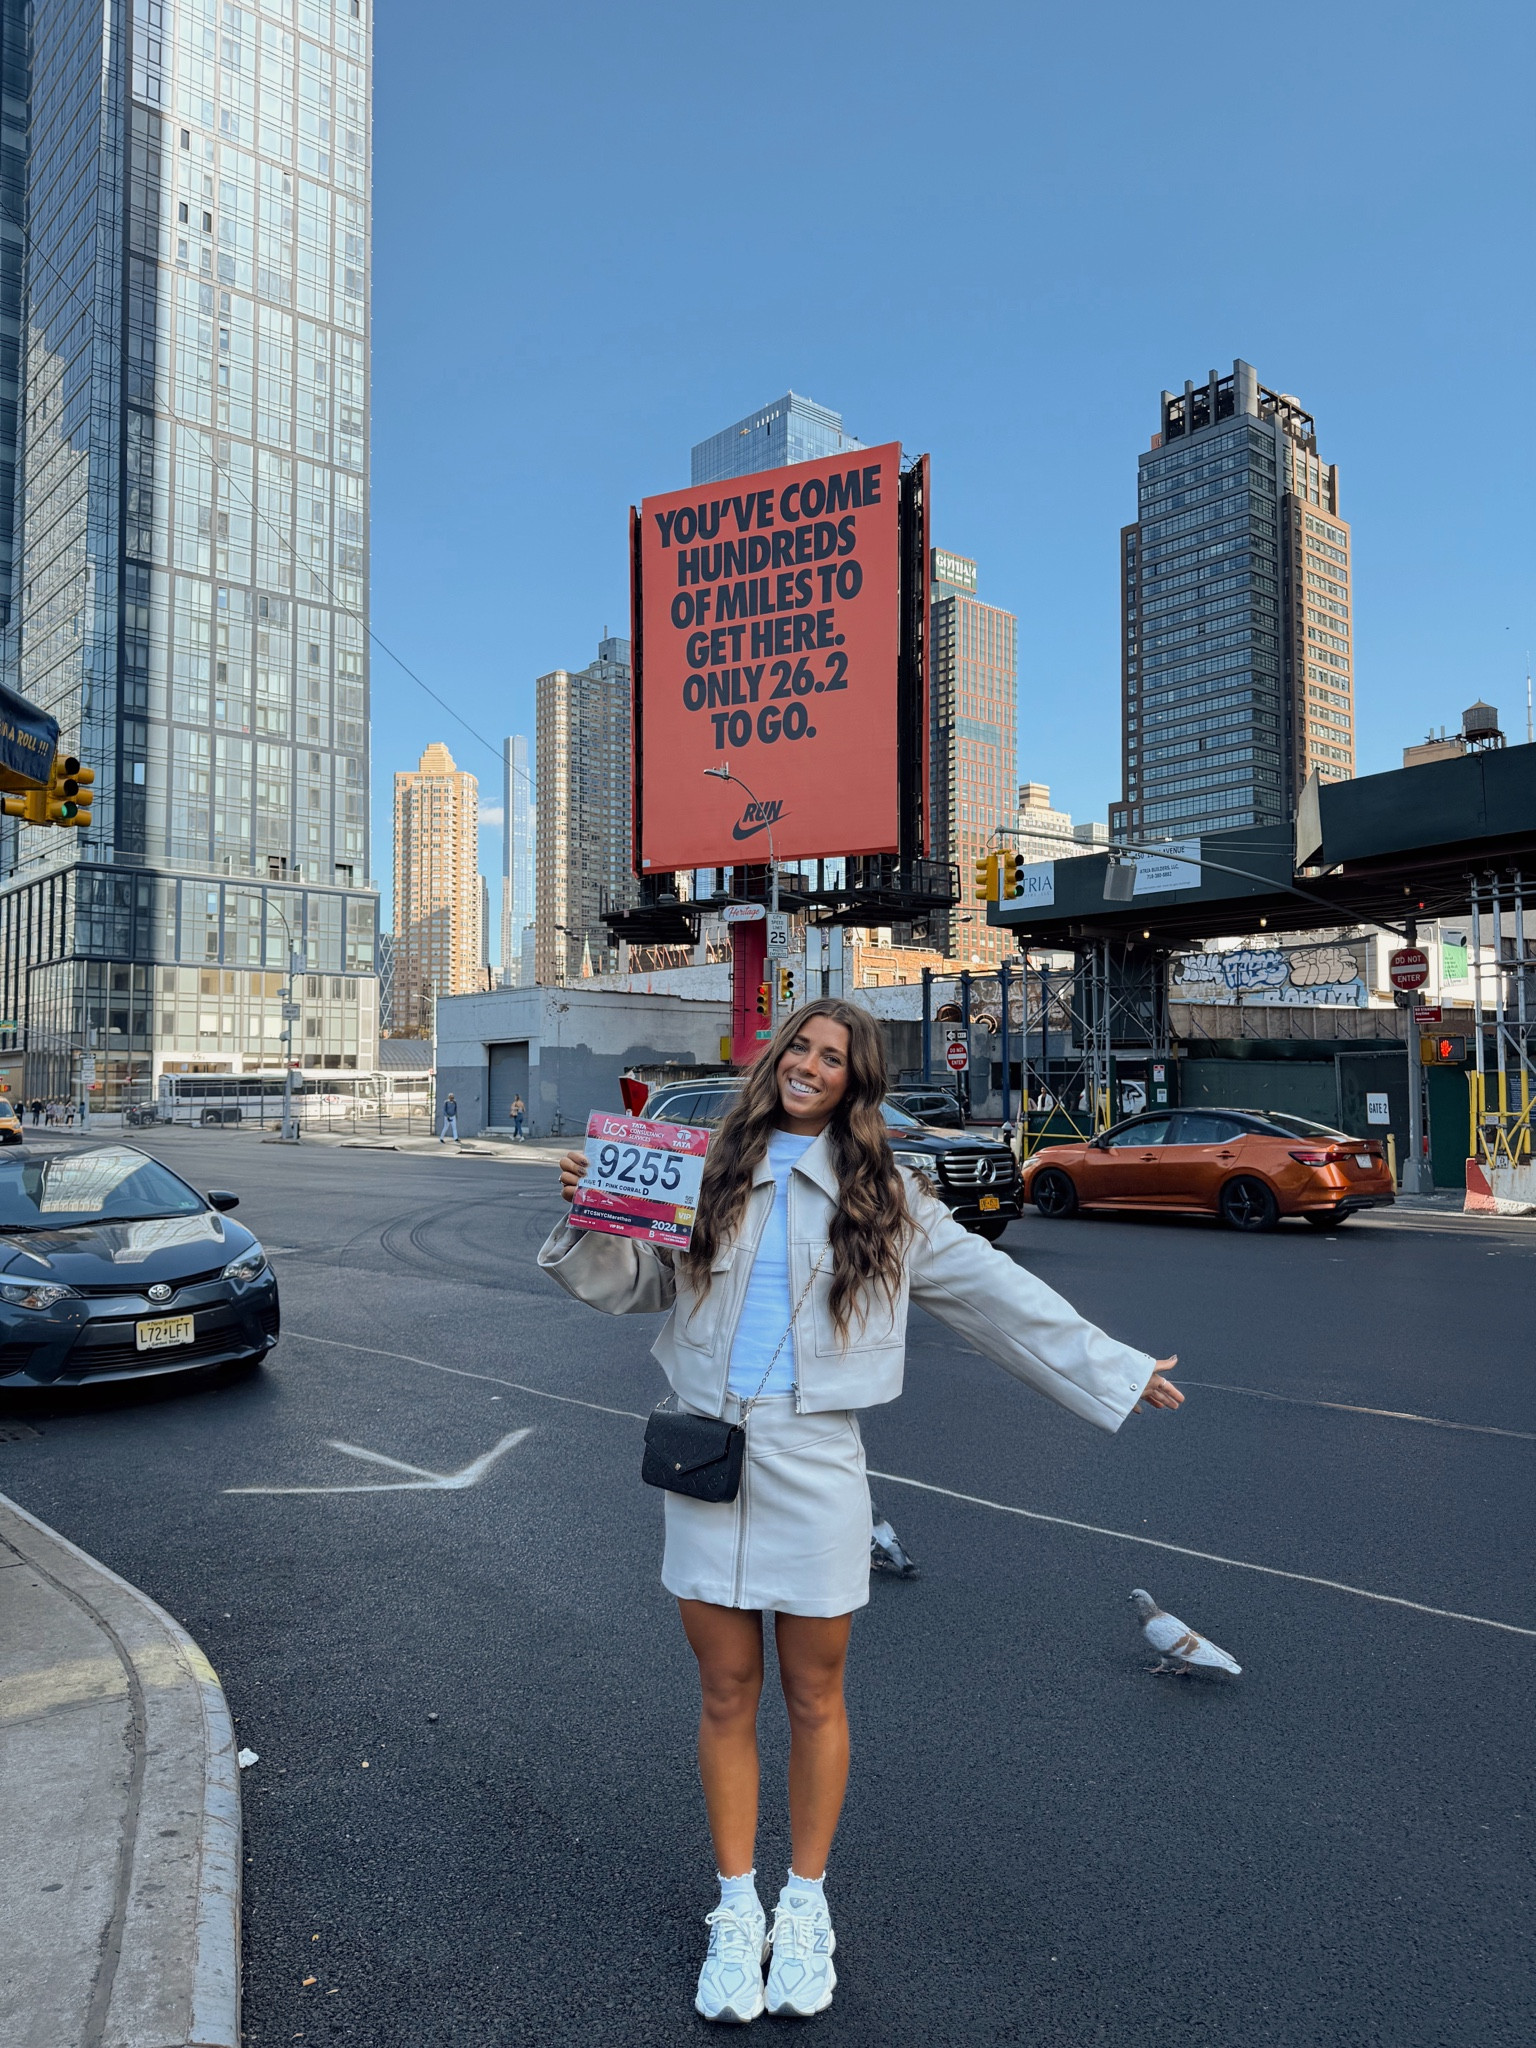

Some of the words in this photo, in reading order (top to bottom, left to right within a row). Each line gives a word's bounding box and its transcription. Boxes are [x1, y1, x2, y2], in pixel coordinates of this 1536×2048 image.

[655, 489, 775, 548] YOU'VE
[779, 464, 882, 523] COME
[677, 515, 857, 587] HUNDREDS
[671, 587, 712, 630] OF
[716, 568, 813, 621] MILES
[817, 559, 863, 604] TO
[686, 624, 746, 669] GET
[750, 608, 846, 660] HERE.
[682, 664, 765, 712] ONLY
[769, 651, 849, 700] 26.2
[711, 708, 753, 750] TO
[756, 701, 817, 744] GO.
[8, 726, 15, 742] A
[17, 730, 37, 751] ROLL
[742, 799, 785, 824] RUN
[1022, 876, 1053, 893] TRIA
[728, 907, 760, 919] Heritage
[770, 931, 786, 944] 25
[1395, 957, 1406, 965] DO
[1407, 954, 1422, 963] NOT
[1397, 973, 1421, 983] ENTER
[1368, 1105, 1382, 1114] GATE
[1383, 1104, 1388, 1114] 2
[603, 1119, 628, 1138] tcs
[629, 1128, 665, 1139] CONSULTANCY
[632, 1122, 647, 1130] TATA
[629, 1135, 651, 1143] SERVICES
[672, 1140, 691, 1149] TATA
[597, 1143, 684, 1191] 9255
[597, 1179, 602, 1187] 1
[618, 1185, 642, 1194] CORRAL
[642, 1187, 650, 1196] D
[583, 1210, 632, 1223] #TCSNYCMarathon
[678, 1212, 692, 1220] VIP
[651, 1219, 677, 1233] 2024
[141, 1327, 162, 1343] L72
[168, 1322, 190, 1339] LFT
